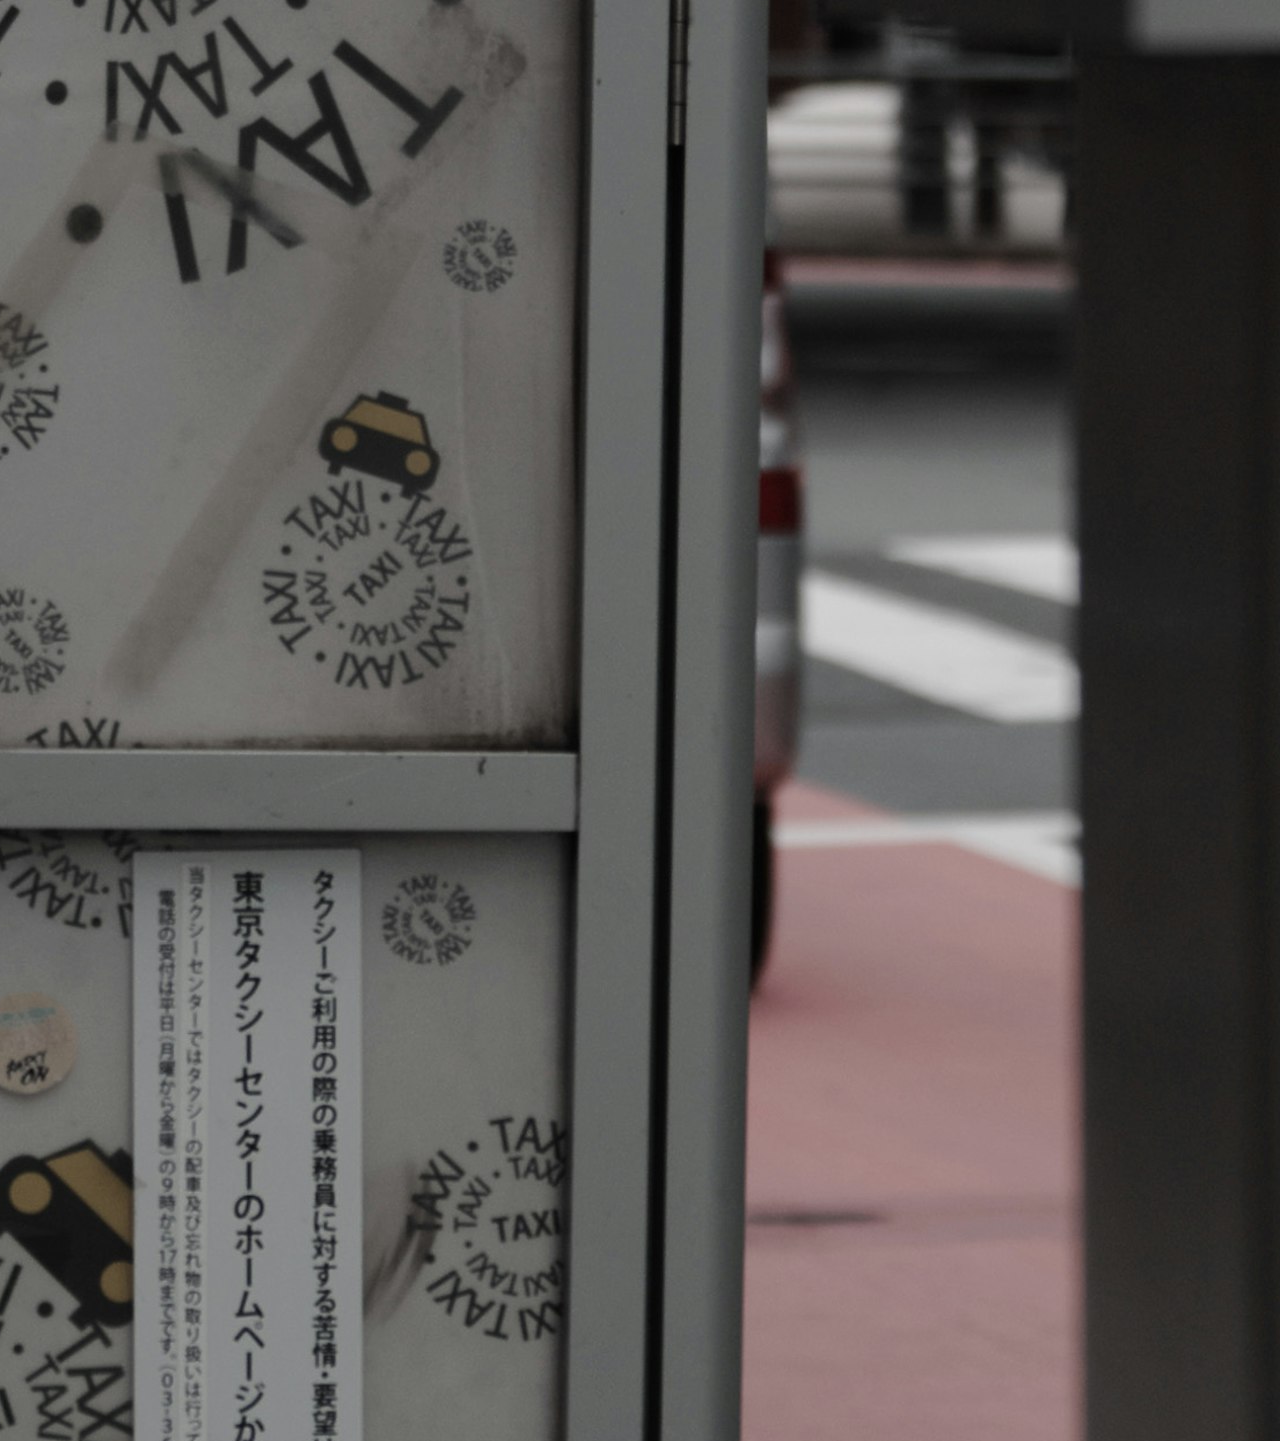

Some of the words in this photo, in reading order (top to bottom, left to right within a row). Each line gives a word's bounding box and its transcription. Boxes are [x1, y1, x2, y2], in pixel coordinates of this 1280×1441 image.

[106, 16, 294, 141] TAXI
[158, 38, 464, 283] TAXI
[12, 384, 60, 450] TAXI
[284, 479, 365, 538] TAXI
[319, 514, 369, 551] TAXI
[406, 493, 473, 564] TAXI
[395, 520, 438, 568] TAXI
[305, 571, 336, 624] TAXI
[343, 551, 403, 606] TAXI
[263, 571, 312, 654] TAXI
[350, 622, 406, 646] TAXI
[401, 584, 436, 633] TAXI
[416, 592, 470, 668] TAXI
[5, 629, 33, 659] TAXI
[335, 650, 424, 689] TAXI
[26, 717, 119, 747] TAXI
[9, 866, 87, 929] TAXI
[489, 1117, 567, 1160] TAX
[406, 1150, 465, 1238] TAXI
[454, 1175, 492, 1233] TAXI
[491, 1209, 561, 1242] TAXI
[466, 1251, 518, 1297] TAXI
[427, 1270, 509, 1340] TAXI
[25, 1354, 73, 1441] TAXI
